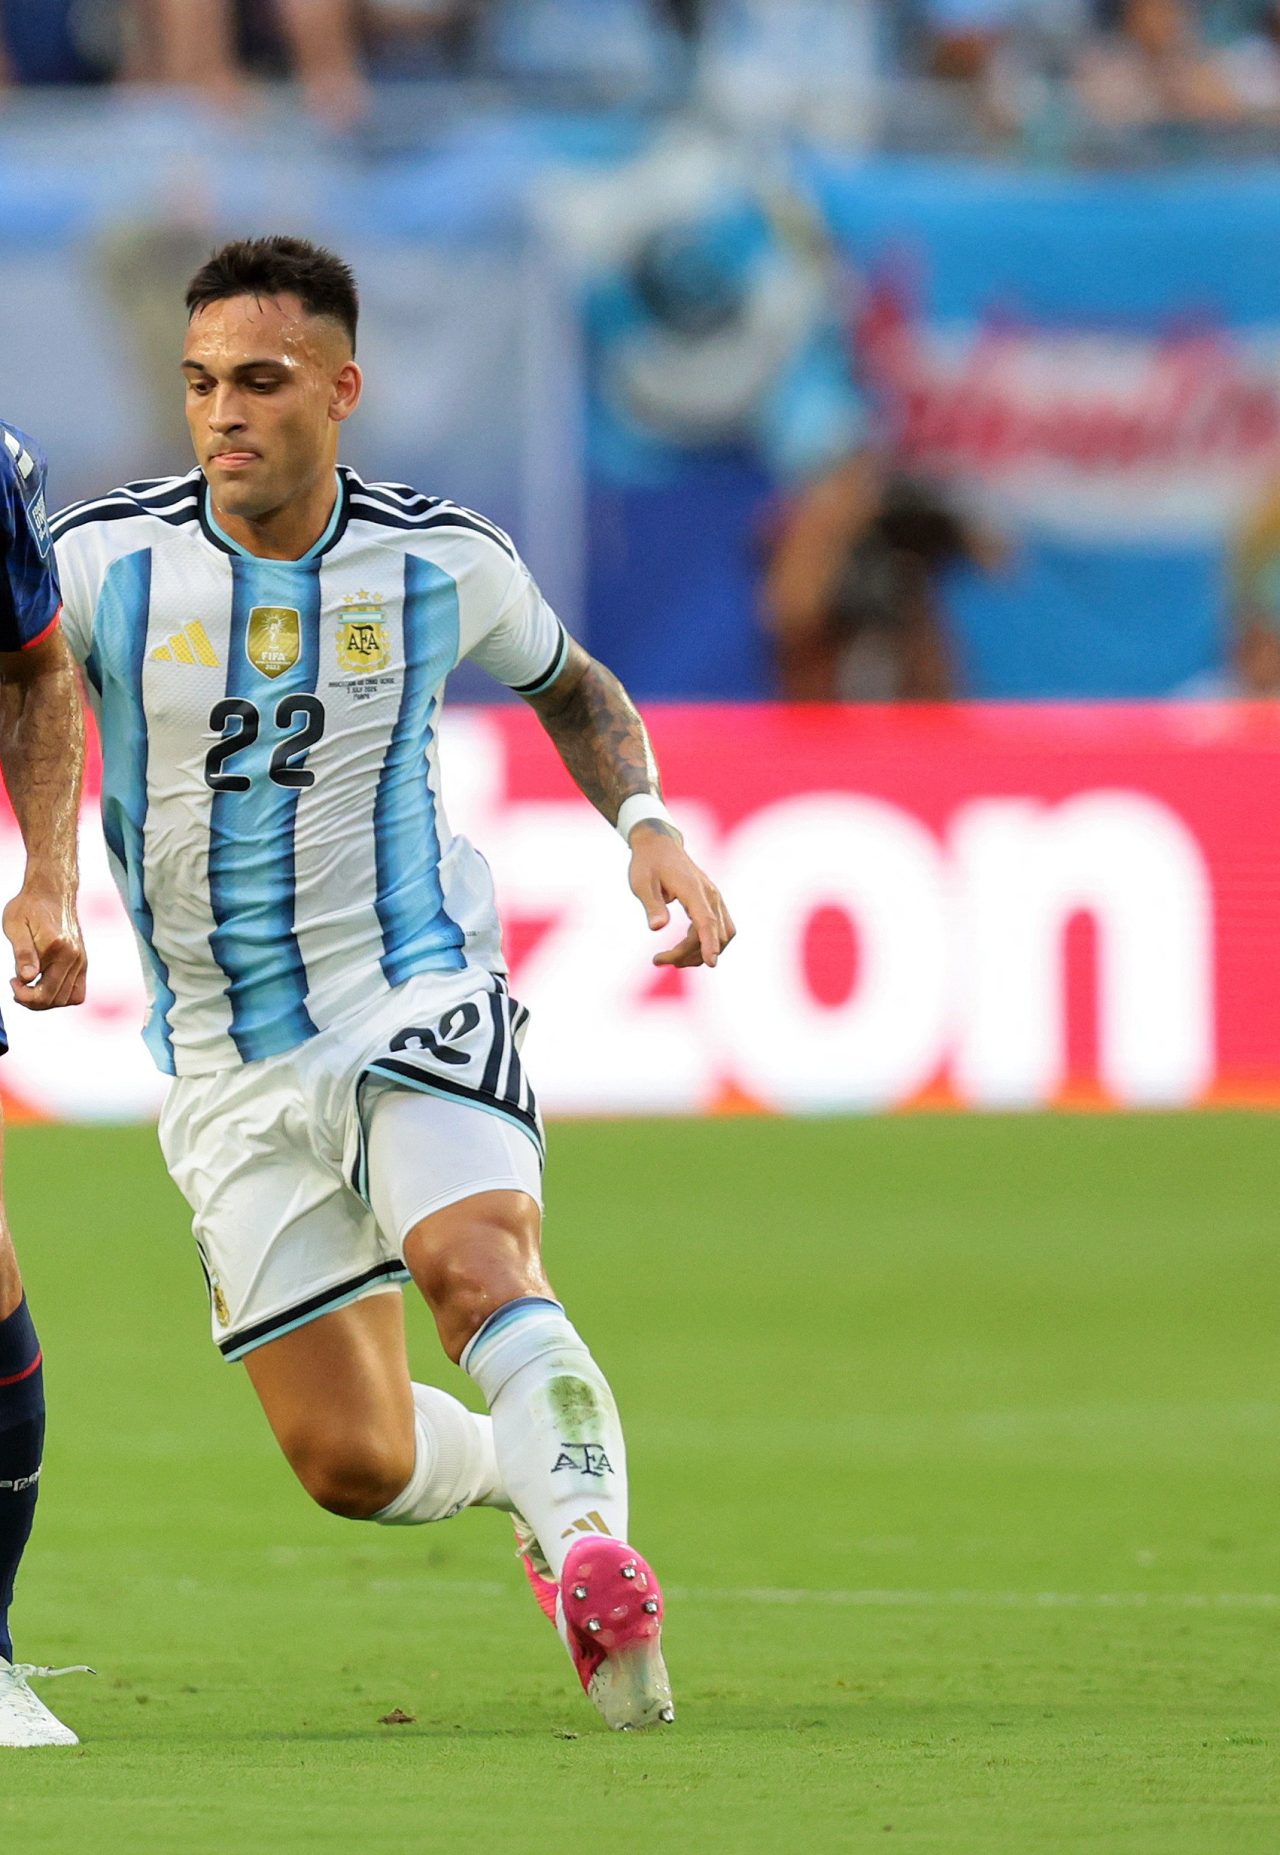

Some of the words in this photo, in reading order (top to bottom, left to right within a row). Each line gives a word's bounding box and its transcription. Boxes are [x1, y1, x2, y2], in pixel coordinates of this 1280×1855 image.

[261, 651, 285, 661] FIFA
[347, 624, 380, 656] AFA
[203, 692, 326, 793] 22
[550, 1442, 615, 1477] AFA
